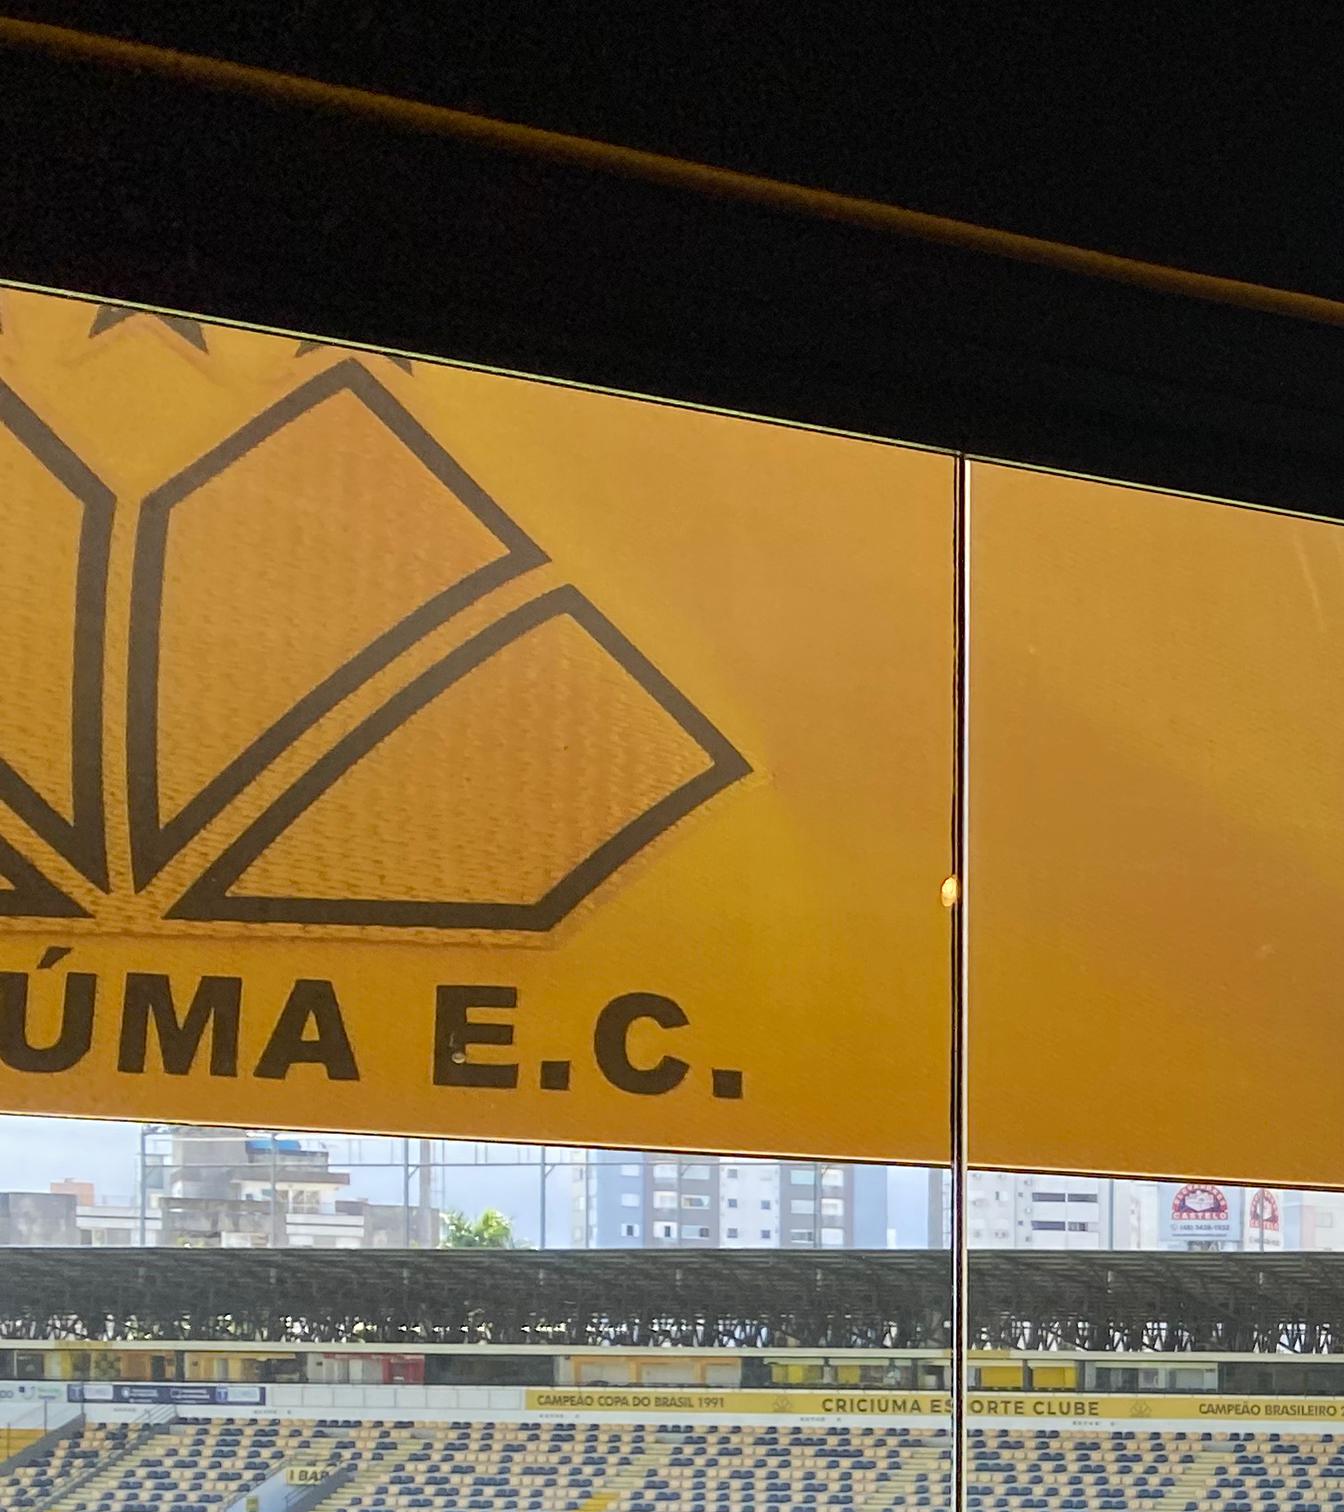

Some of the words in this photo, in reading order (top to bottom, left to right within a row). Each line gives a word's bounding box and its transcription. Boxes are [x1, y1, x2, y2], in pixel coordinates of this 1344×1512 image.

[0, 946, 360, 1081] ÚMA
[433, 985, 744, 1099] E.C.
[597, 1396, 629, 1407] COPA
[632, 1396, 650, 1407] DO
[654, 1397, 694, 1408] BRASIL
[698, 1398, 724, 1408] 1991
[930, 1399, 1024, 1415] ESORTE
[1033, 1401, 1099, 1415] CLUBE
[1199, 1401, 1261, 1415] CAMPEÃO
[1265, 1405, 1337, 1416] BRASILEIRO
